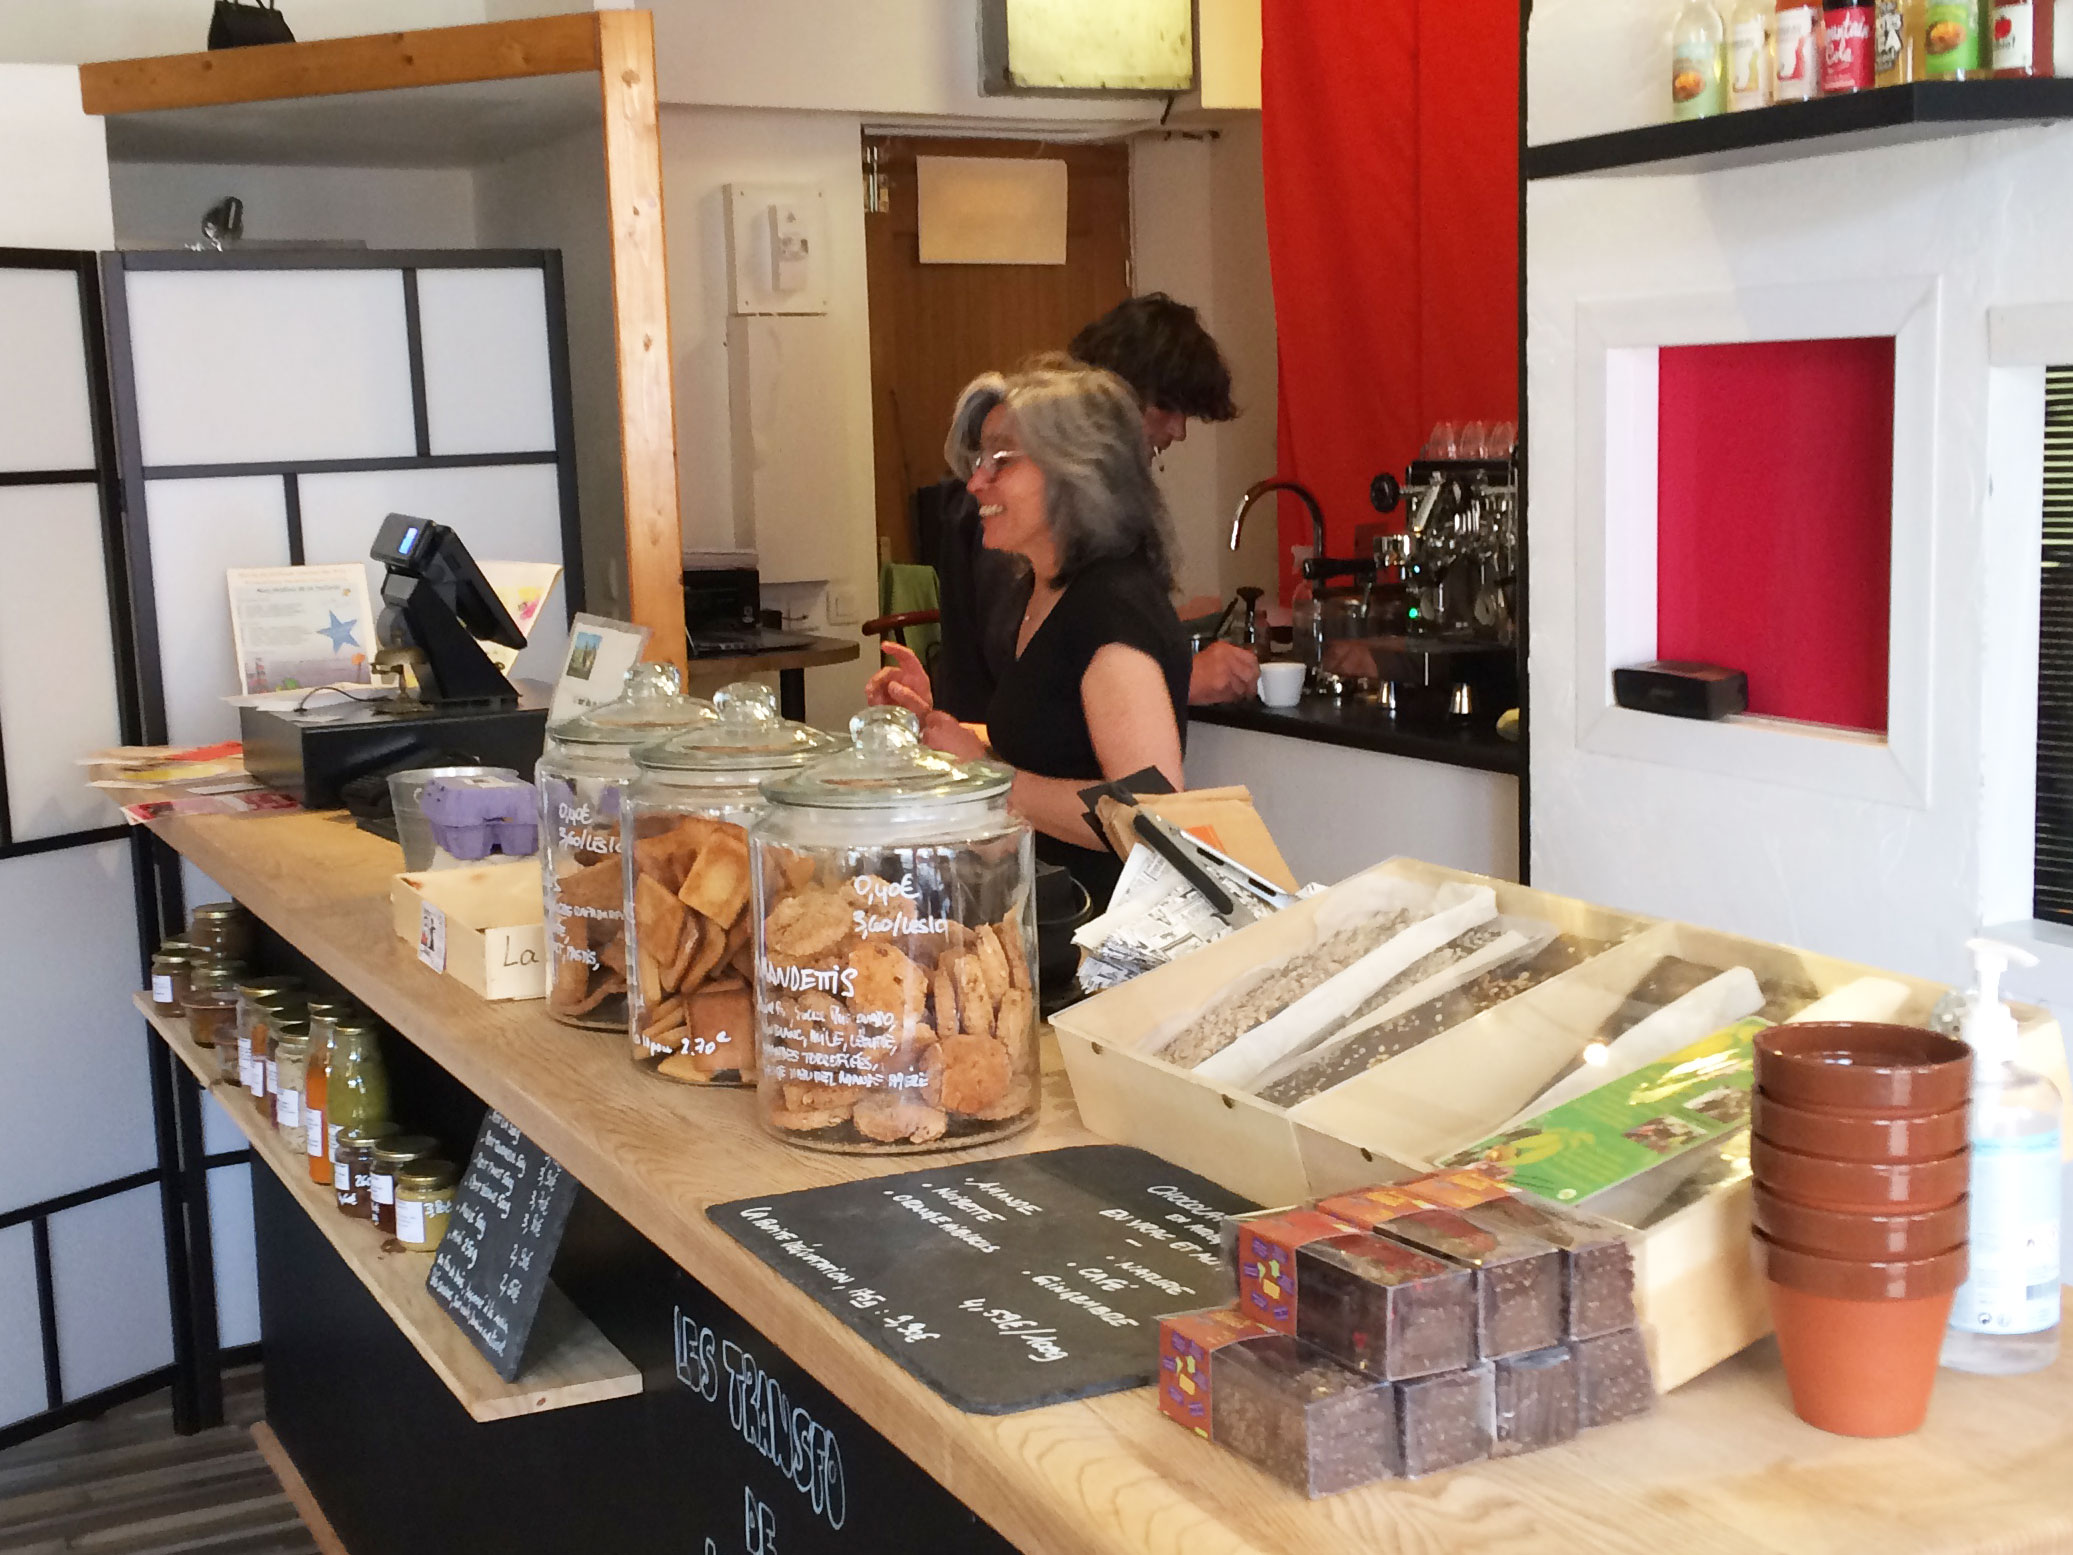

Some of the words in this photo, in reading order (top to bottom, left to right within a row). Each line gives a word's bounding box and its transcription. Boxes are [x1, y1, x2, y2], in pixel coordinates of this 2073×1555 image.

[503, 935, 540, 967] La
[892, 1194, 953, 1225] ORANGE
[931, 1187, 1007, 1222] NOISETTE
[964, 1181, 1043, 1216] AMANDE
[1147, 1185, 1225, 1222] CHOCOLA
[1099, 1208, 1135, 1221] EN
[1125, 1219, 1177, 1240] VRAC
[1169, 1241, 1203, 1252] ET
[1077, 1268, 1140, 1292] CAFÉ
[1114, 1261, 1196, 1296] NATURE
[1031, 1275, 1140, 1328] GINGEMBRE
[674, 1304, 718, 1402] LES
